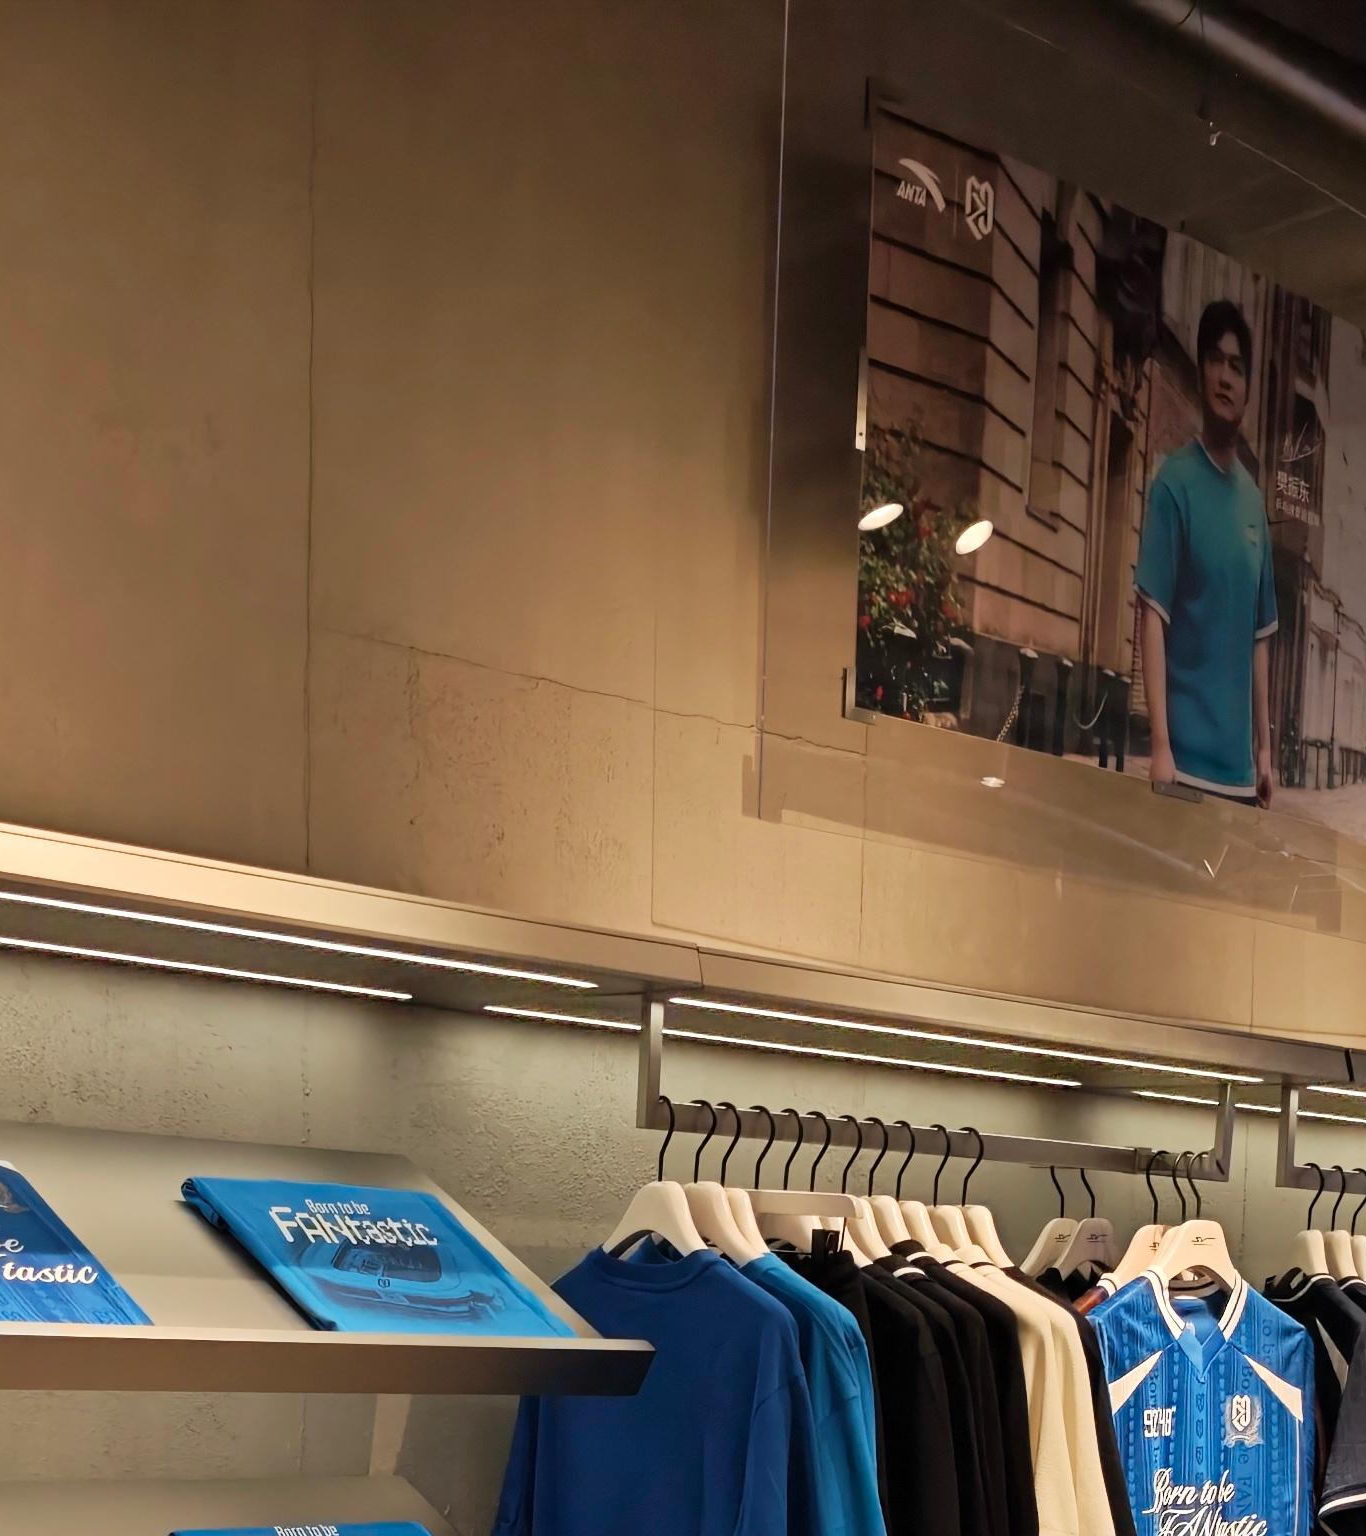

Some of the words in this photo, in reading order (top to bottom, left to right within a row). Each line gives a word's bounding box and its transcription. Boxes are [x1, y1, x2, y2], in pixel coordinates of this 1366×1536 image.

[896, 180, 927, 208] ANTA
[305, 1198, 338, 1216] Born
[338, 1201, 354, 1215] to
[354, 1201, 371, 1216] be
[269, 1206, 438, 1246] FANtastic
[1142, 1467, 1199, 1514] Born
[1199, 1480, 1217, 1505] to
[1216, 1469, 1236, 1503] be
